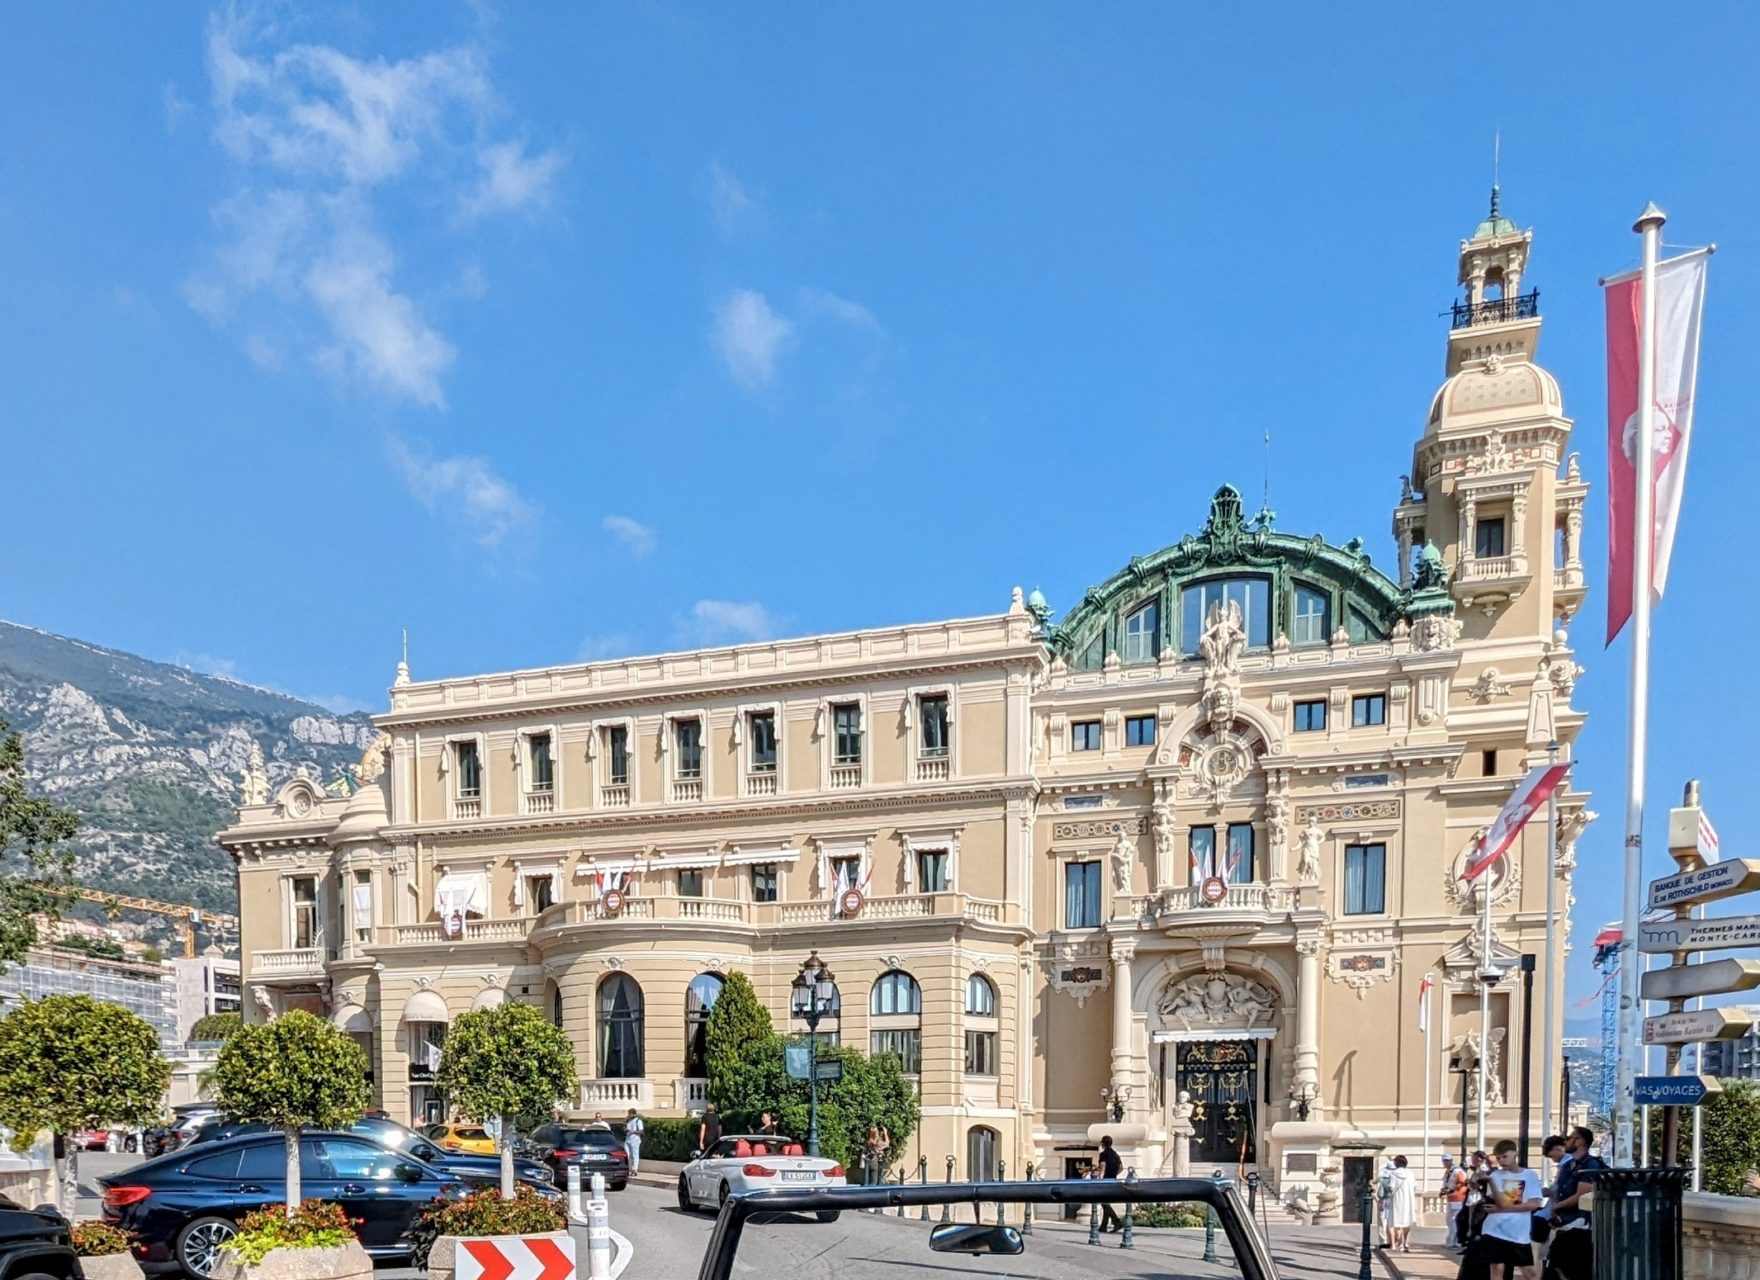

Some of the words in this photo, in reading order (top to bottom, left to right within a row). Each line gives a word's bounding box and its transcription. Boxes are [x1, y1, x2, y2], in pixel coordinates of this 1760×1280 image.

[1655, 879, 1682, 893] BANQUE
[1684, 876, 1694, 885] DE
[1697, 866, 1729, 881] GESTION
[1668, 883, 1710, 900] ROTHSCHILD
[1690, 925, 1734, 935] THERMES
